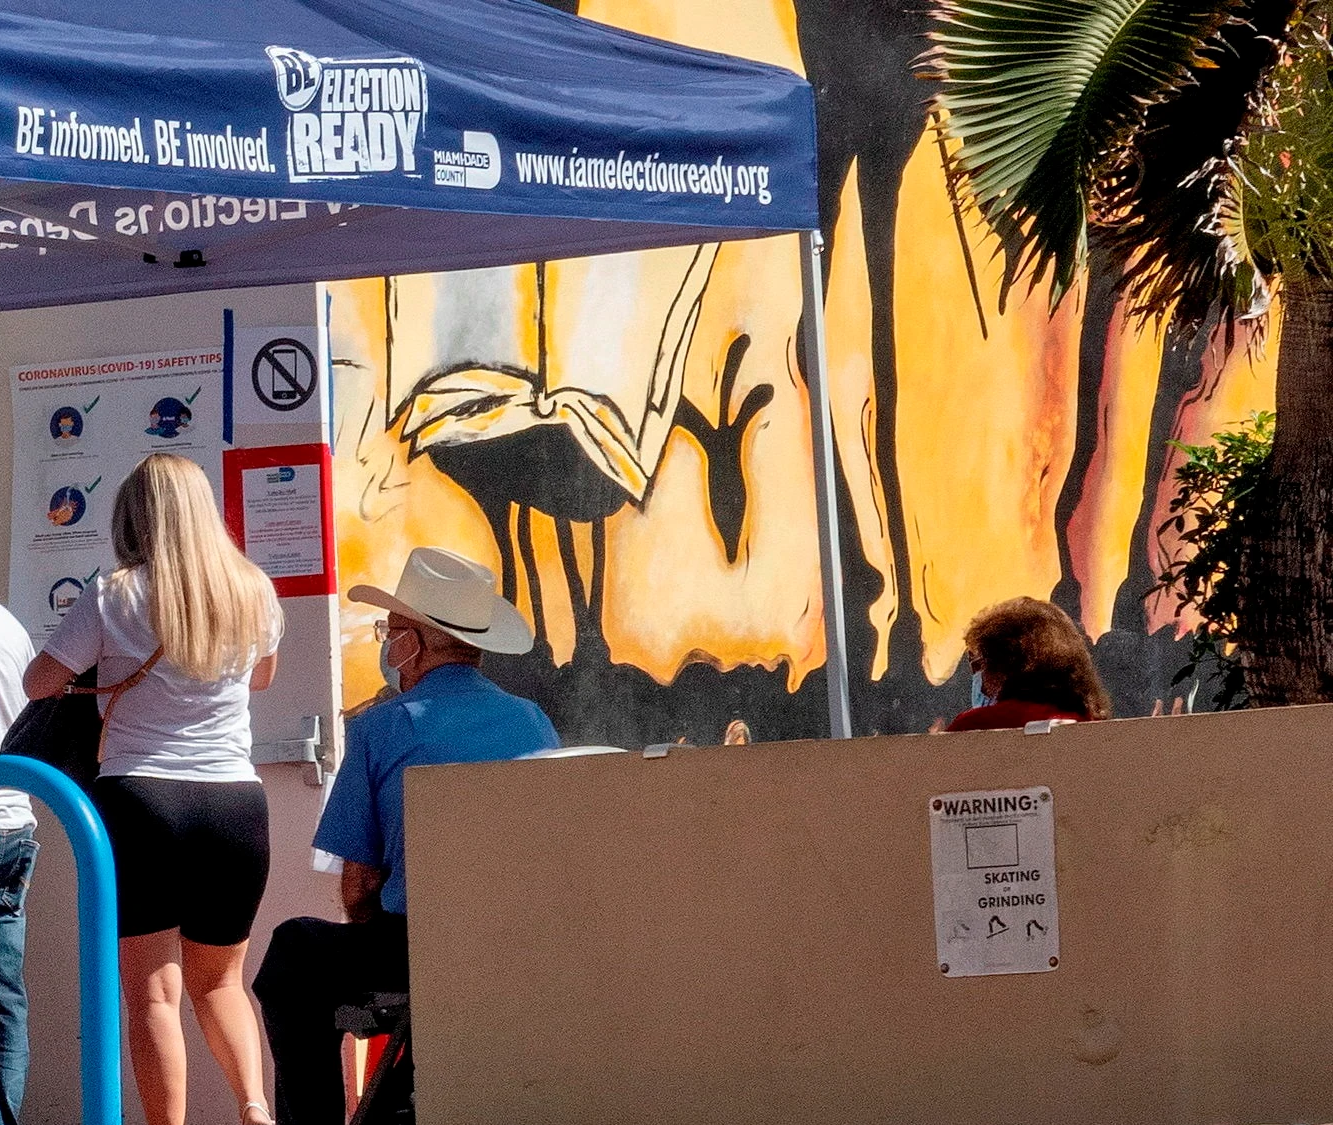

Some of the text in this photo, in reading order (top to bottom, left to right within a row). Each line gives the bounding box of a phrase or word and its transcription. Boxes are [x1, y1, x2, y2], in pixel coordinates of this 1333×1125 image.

[277, 52, 317, 96] BE
[321, 68, 420, 112] ELECTION
[16, 106, 276, 174] BE informed. BE involved.
[294, 112, 420, 174] READY
[436, 170, 464, 184] COUNTY
[515, 147, 773, 206] www.iamelectionready.org
[18, 364, 97, 383] CORONAVIRUS
[97, 359, 156, 376] (COVID-19)
[157, 354, 198, 370] SAFETY
[199, 352, 223, 365] TIPS
[943, 795, 1039, 815] WARNING:
[984, 869, 1041, 885] SKATING
[978, 893, 1046, 909] GRINDING
